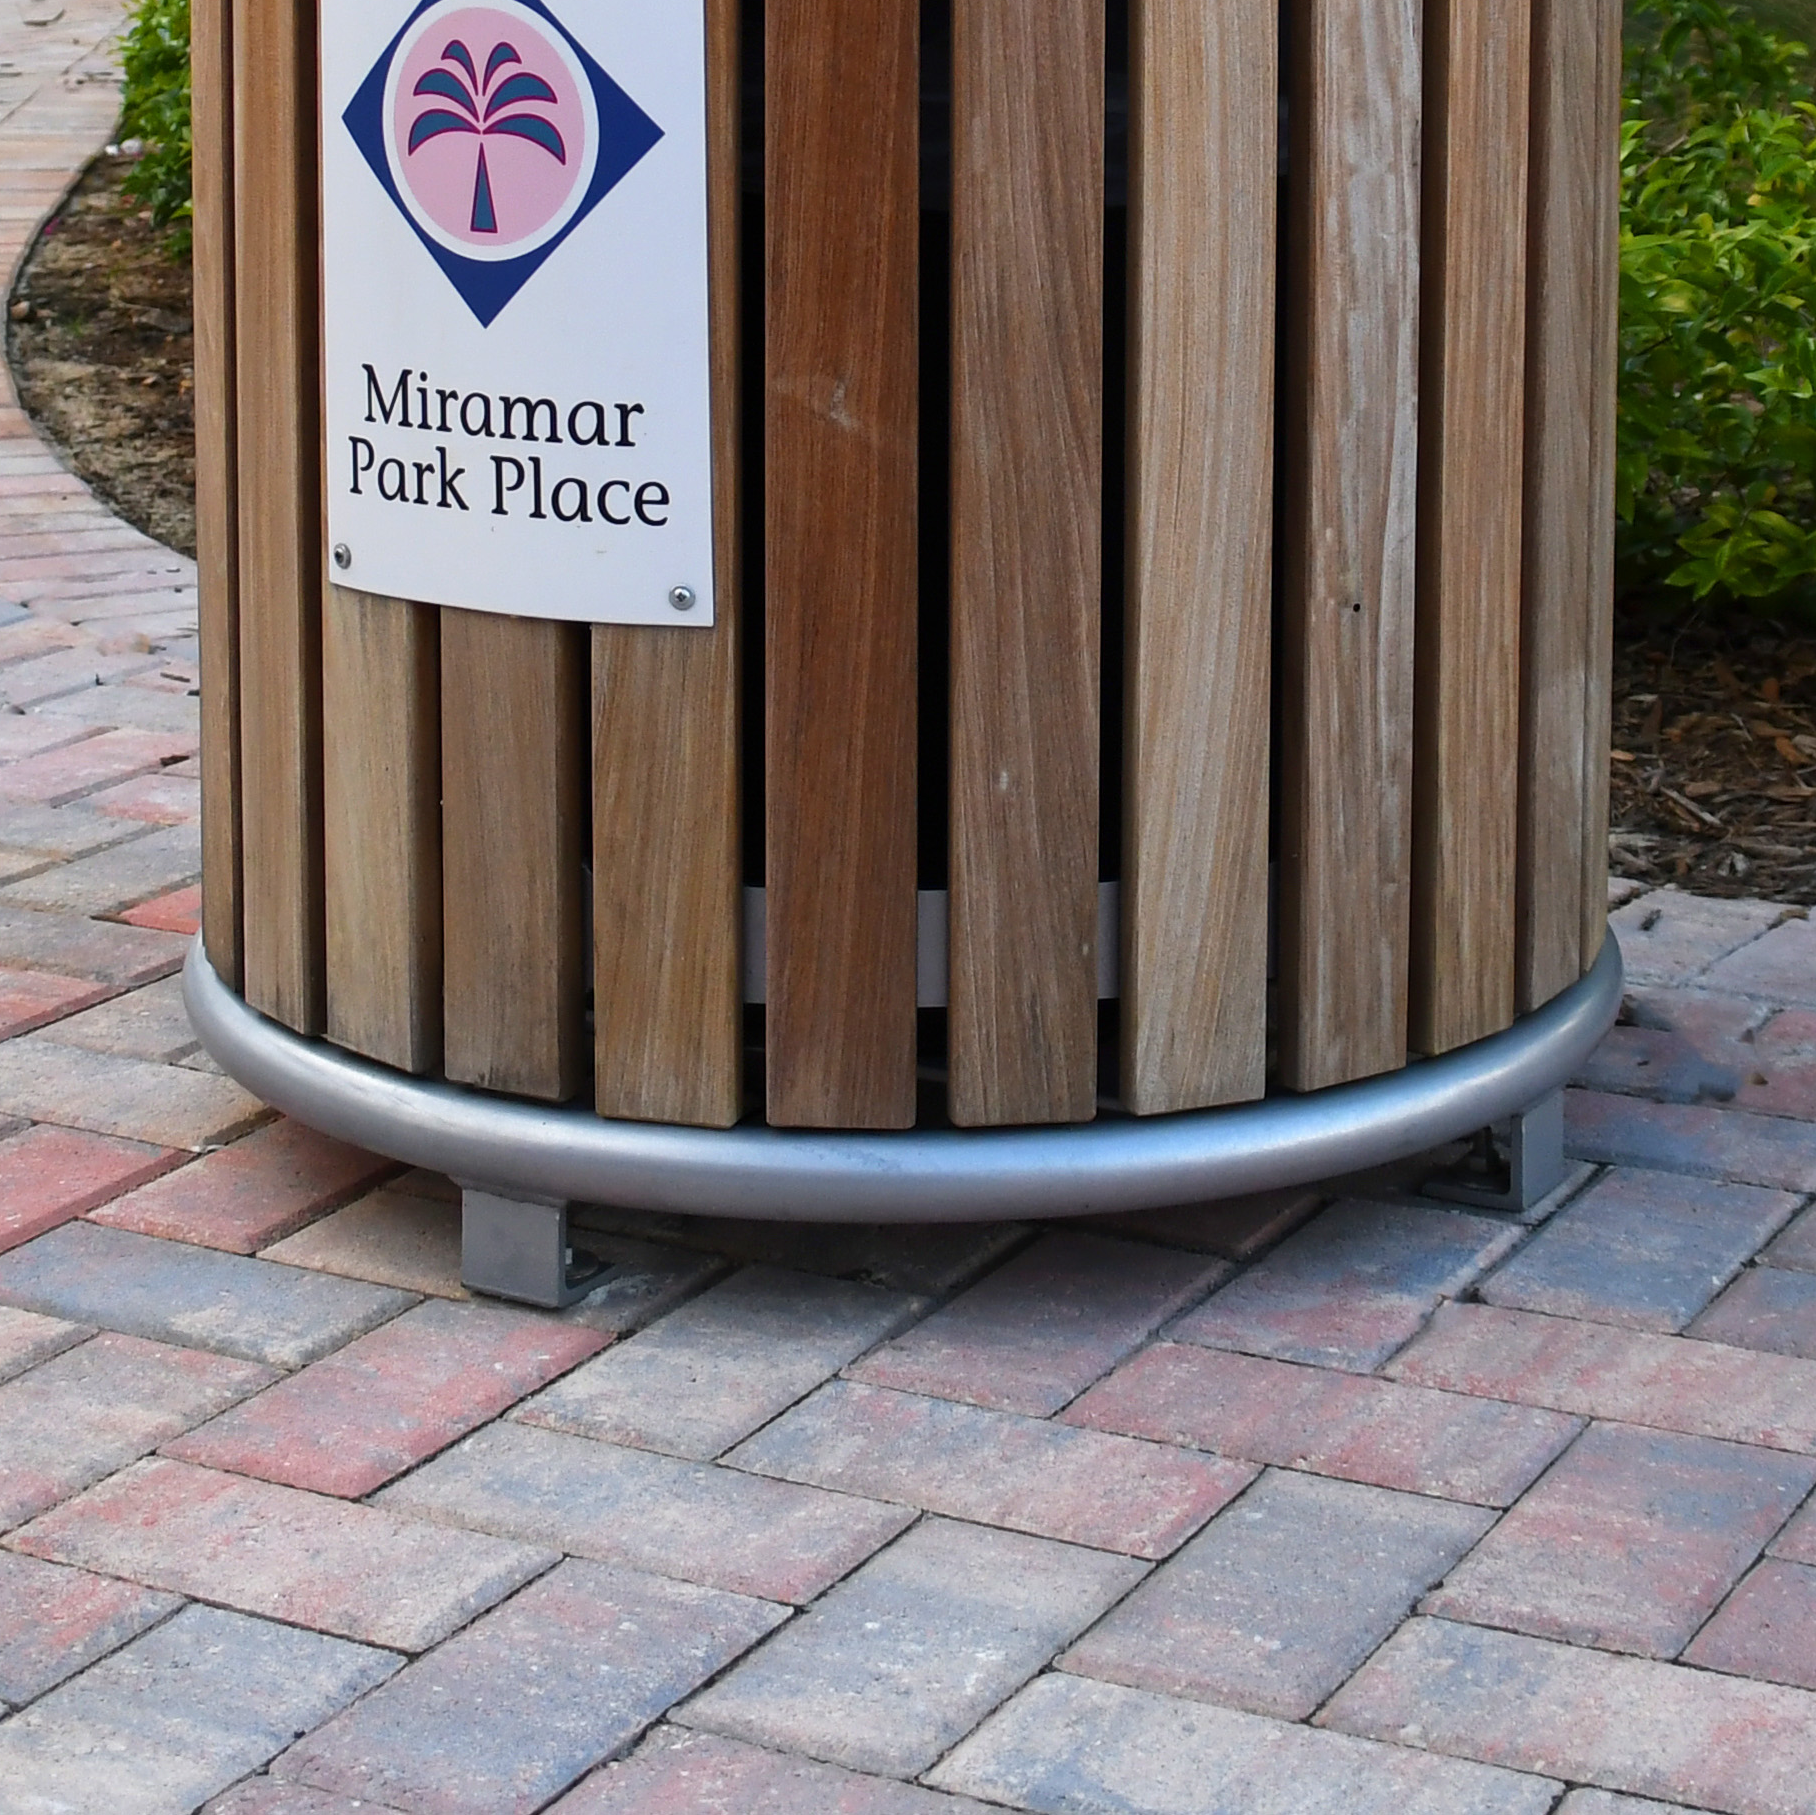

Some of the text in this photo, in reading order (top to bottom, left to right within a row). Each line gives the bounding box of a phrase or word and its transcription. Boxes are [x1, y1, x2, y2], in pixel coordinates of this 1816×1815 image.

[361, 363, 645, 447] Miramar
[348, 435, 670, 527] Park Place
